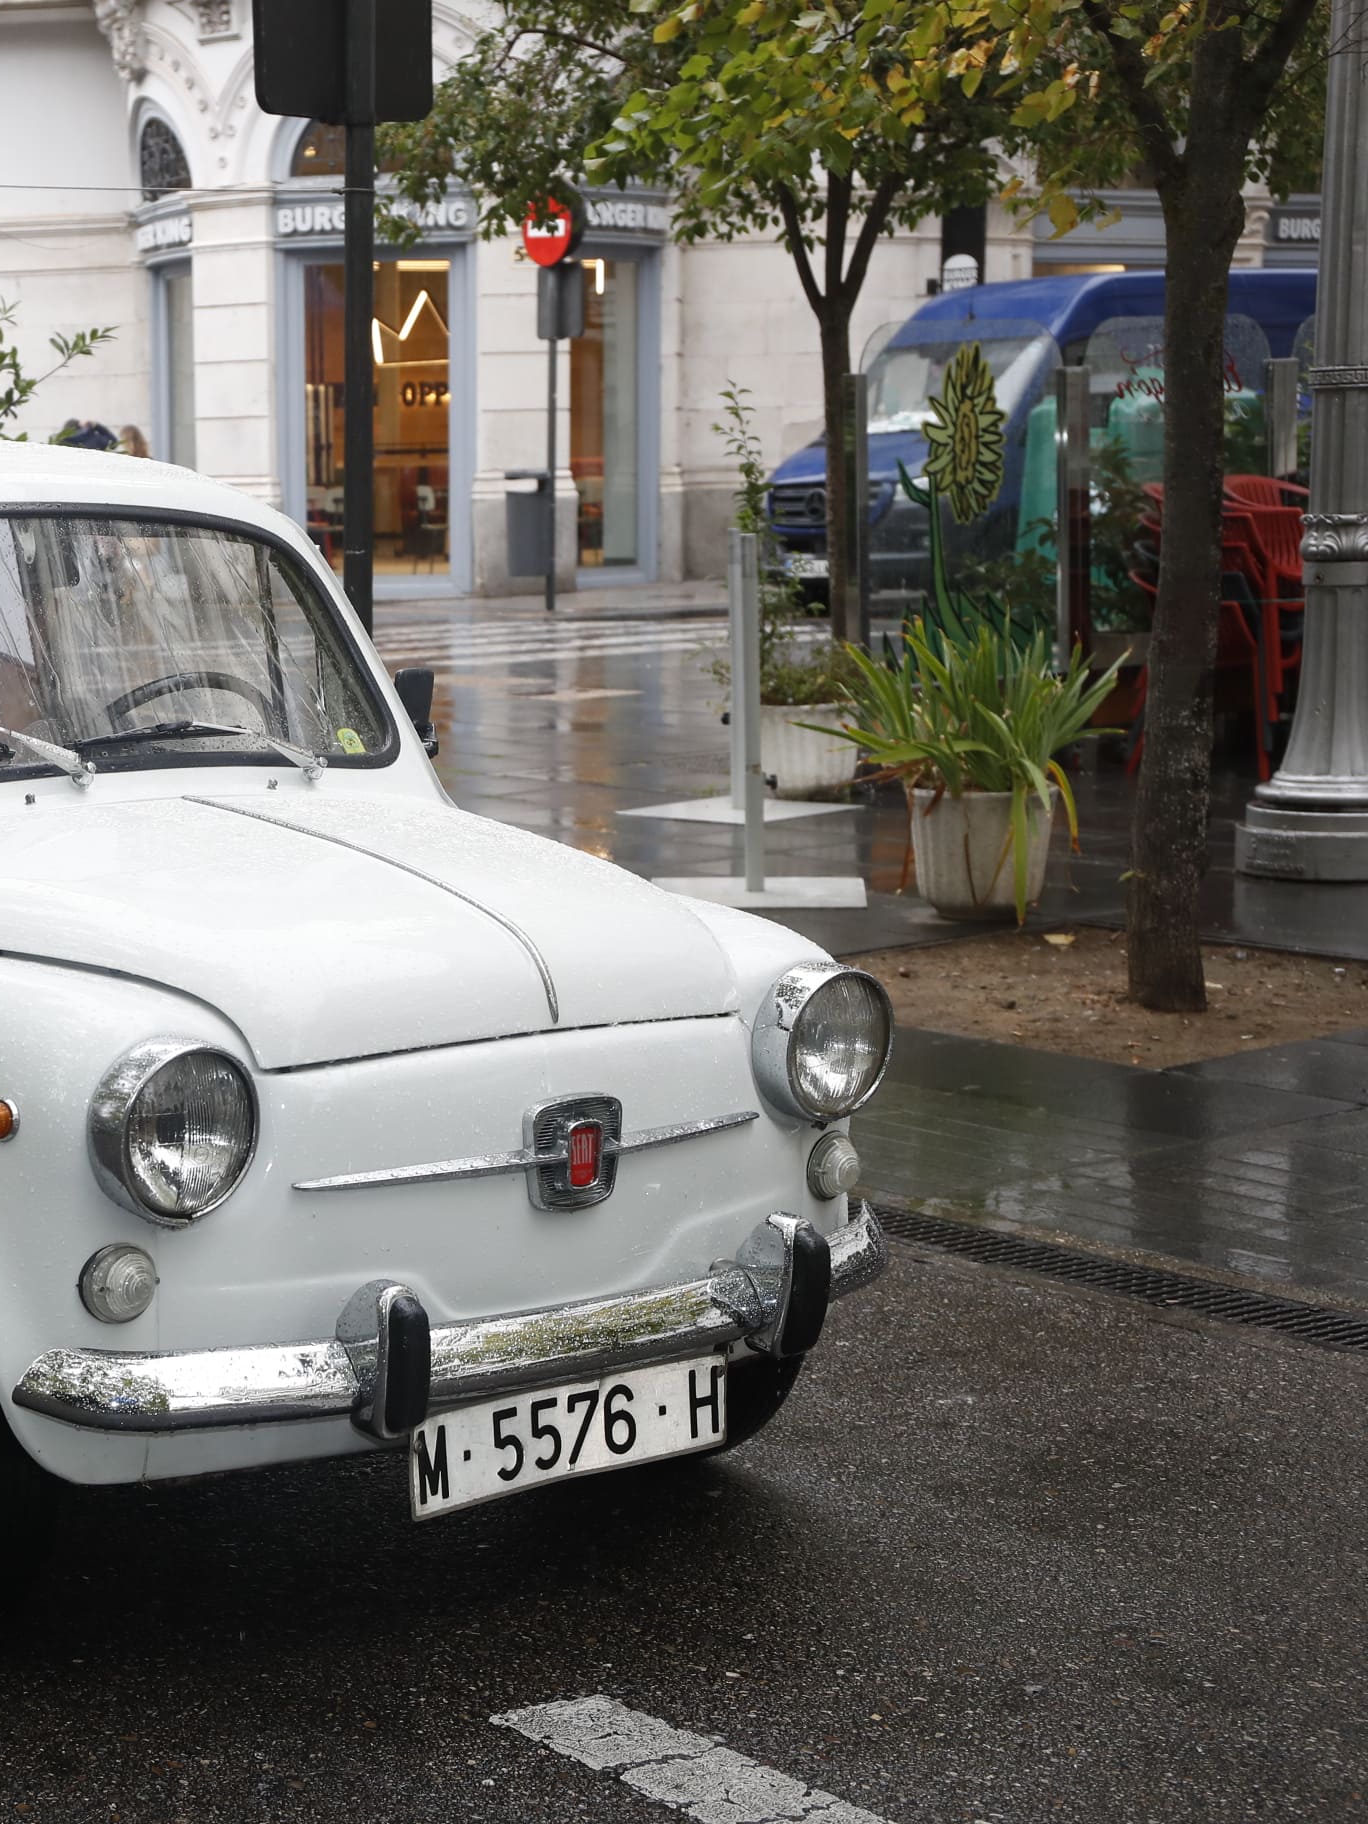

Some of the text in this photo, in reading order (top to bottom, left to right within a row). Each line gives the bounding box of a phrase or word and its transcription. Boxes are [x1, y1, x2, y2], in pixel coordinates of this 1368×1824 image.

[277, 207, 346, 234] BURG
[586, 202, 644, 229] URGER
[1278, 218, 1321, 239] BURG
